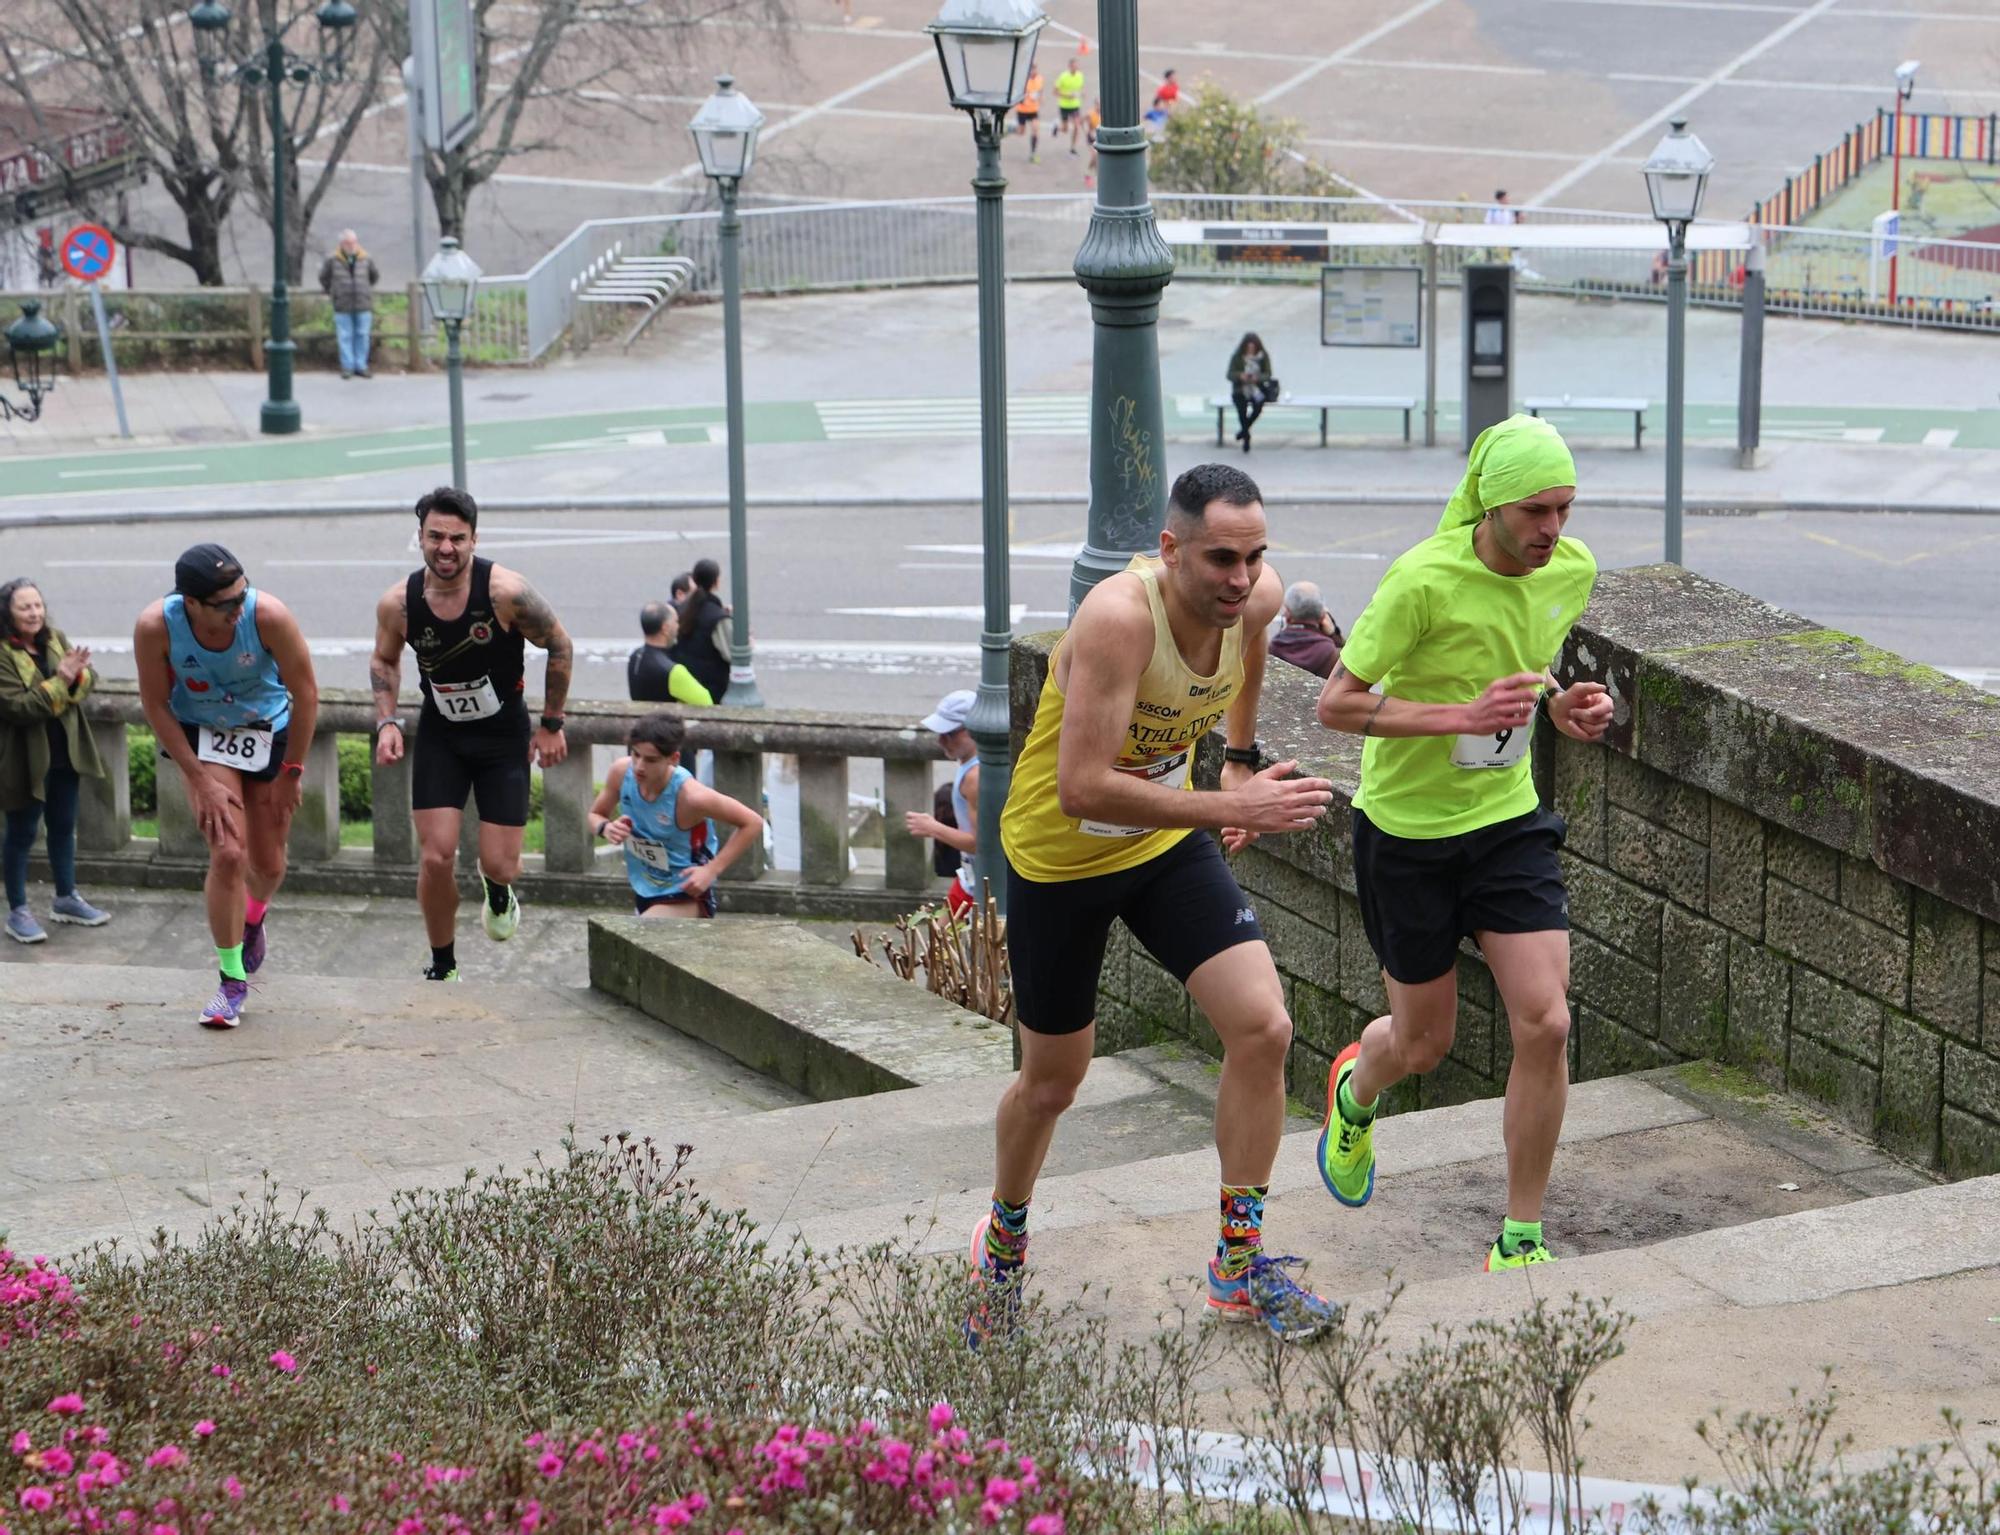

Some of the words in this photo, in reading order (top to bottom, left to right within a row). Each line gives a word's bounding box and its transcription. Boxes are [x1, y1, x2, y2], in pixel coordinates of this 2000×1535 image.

[445, 696, 481, 714] 121
[212, 732, 256, 758] 268
[1494, 727, 1513, 754] 9
[632, 840, 657, 861] 15
